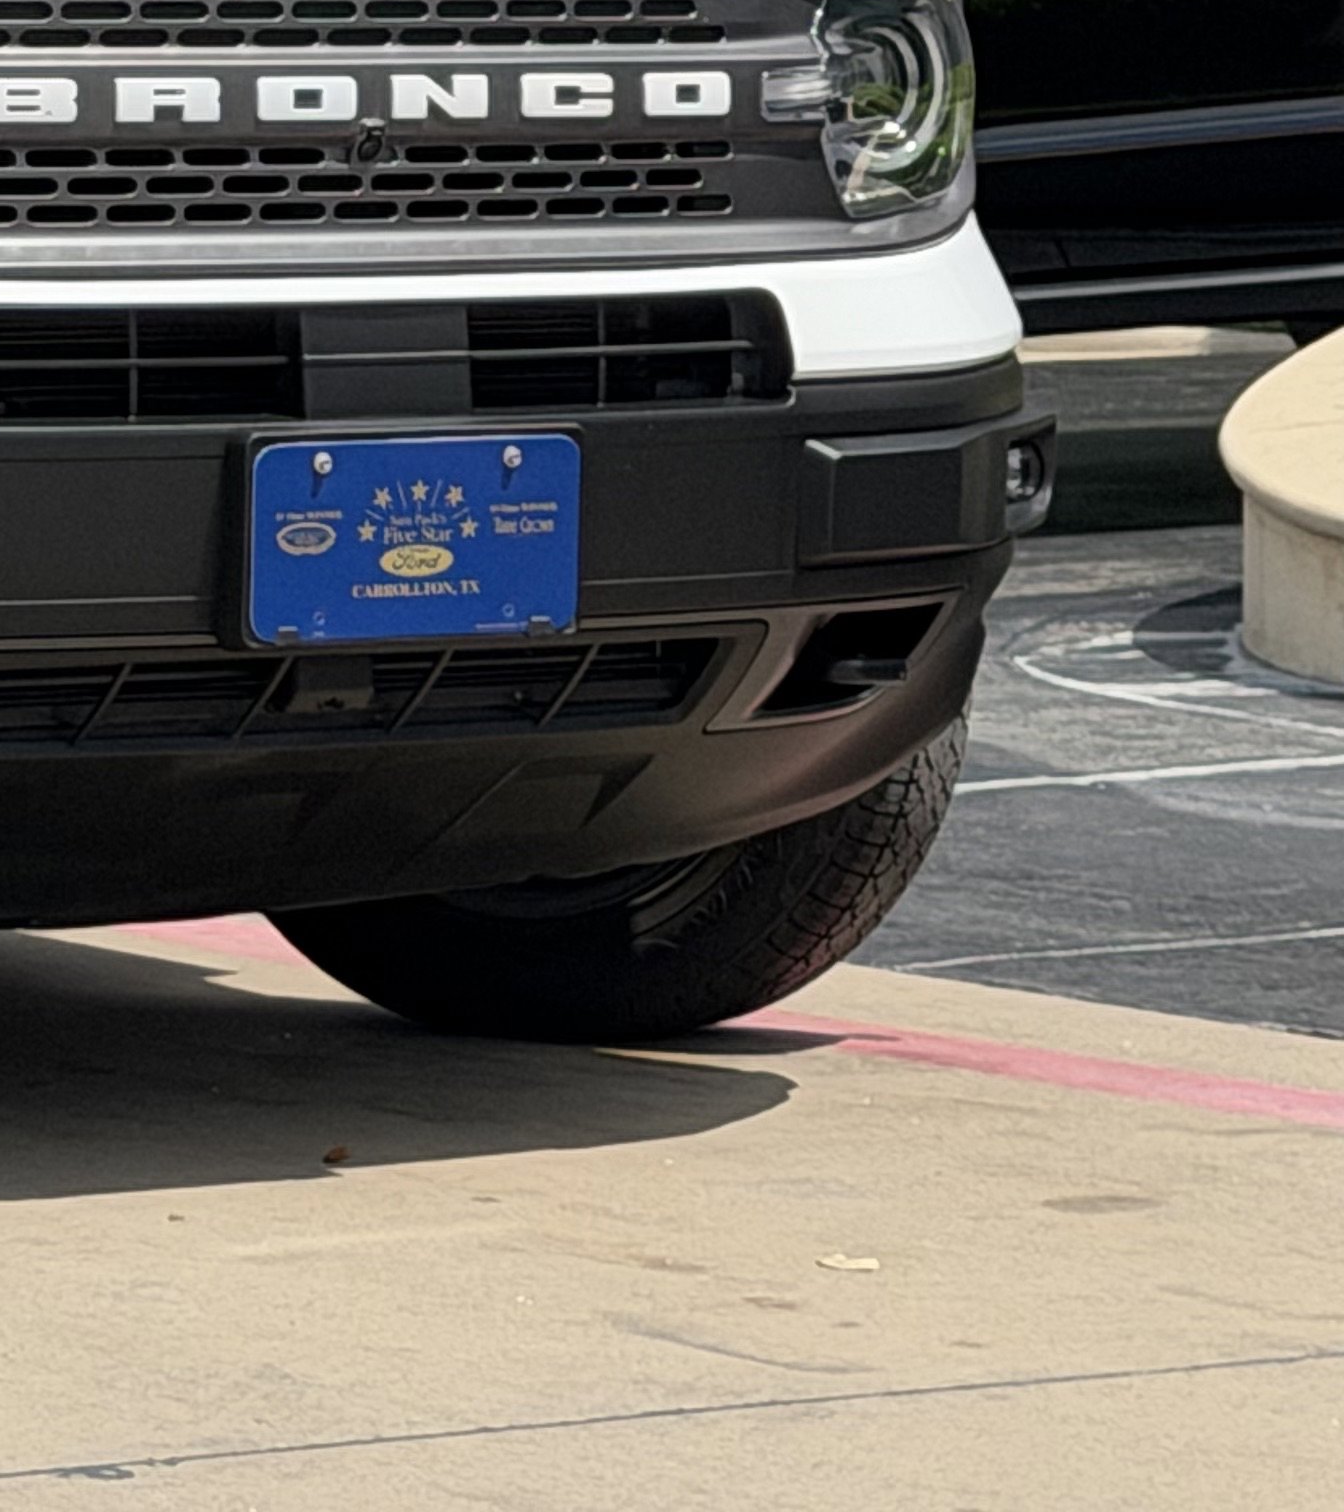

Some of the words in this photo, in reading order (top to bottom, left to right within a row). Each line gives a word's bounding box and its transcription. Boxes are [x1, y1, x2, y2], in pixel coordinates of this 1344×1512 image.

[383, 526, 417, 544] Five
[421, 525, 453, 542] Star
[392, 552, 442, 570] Ford
[460, 579, 481, 595] TX
